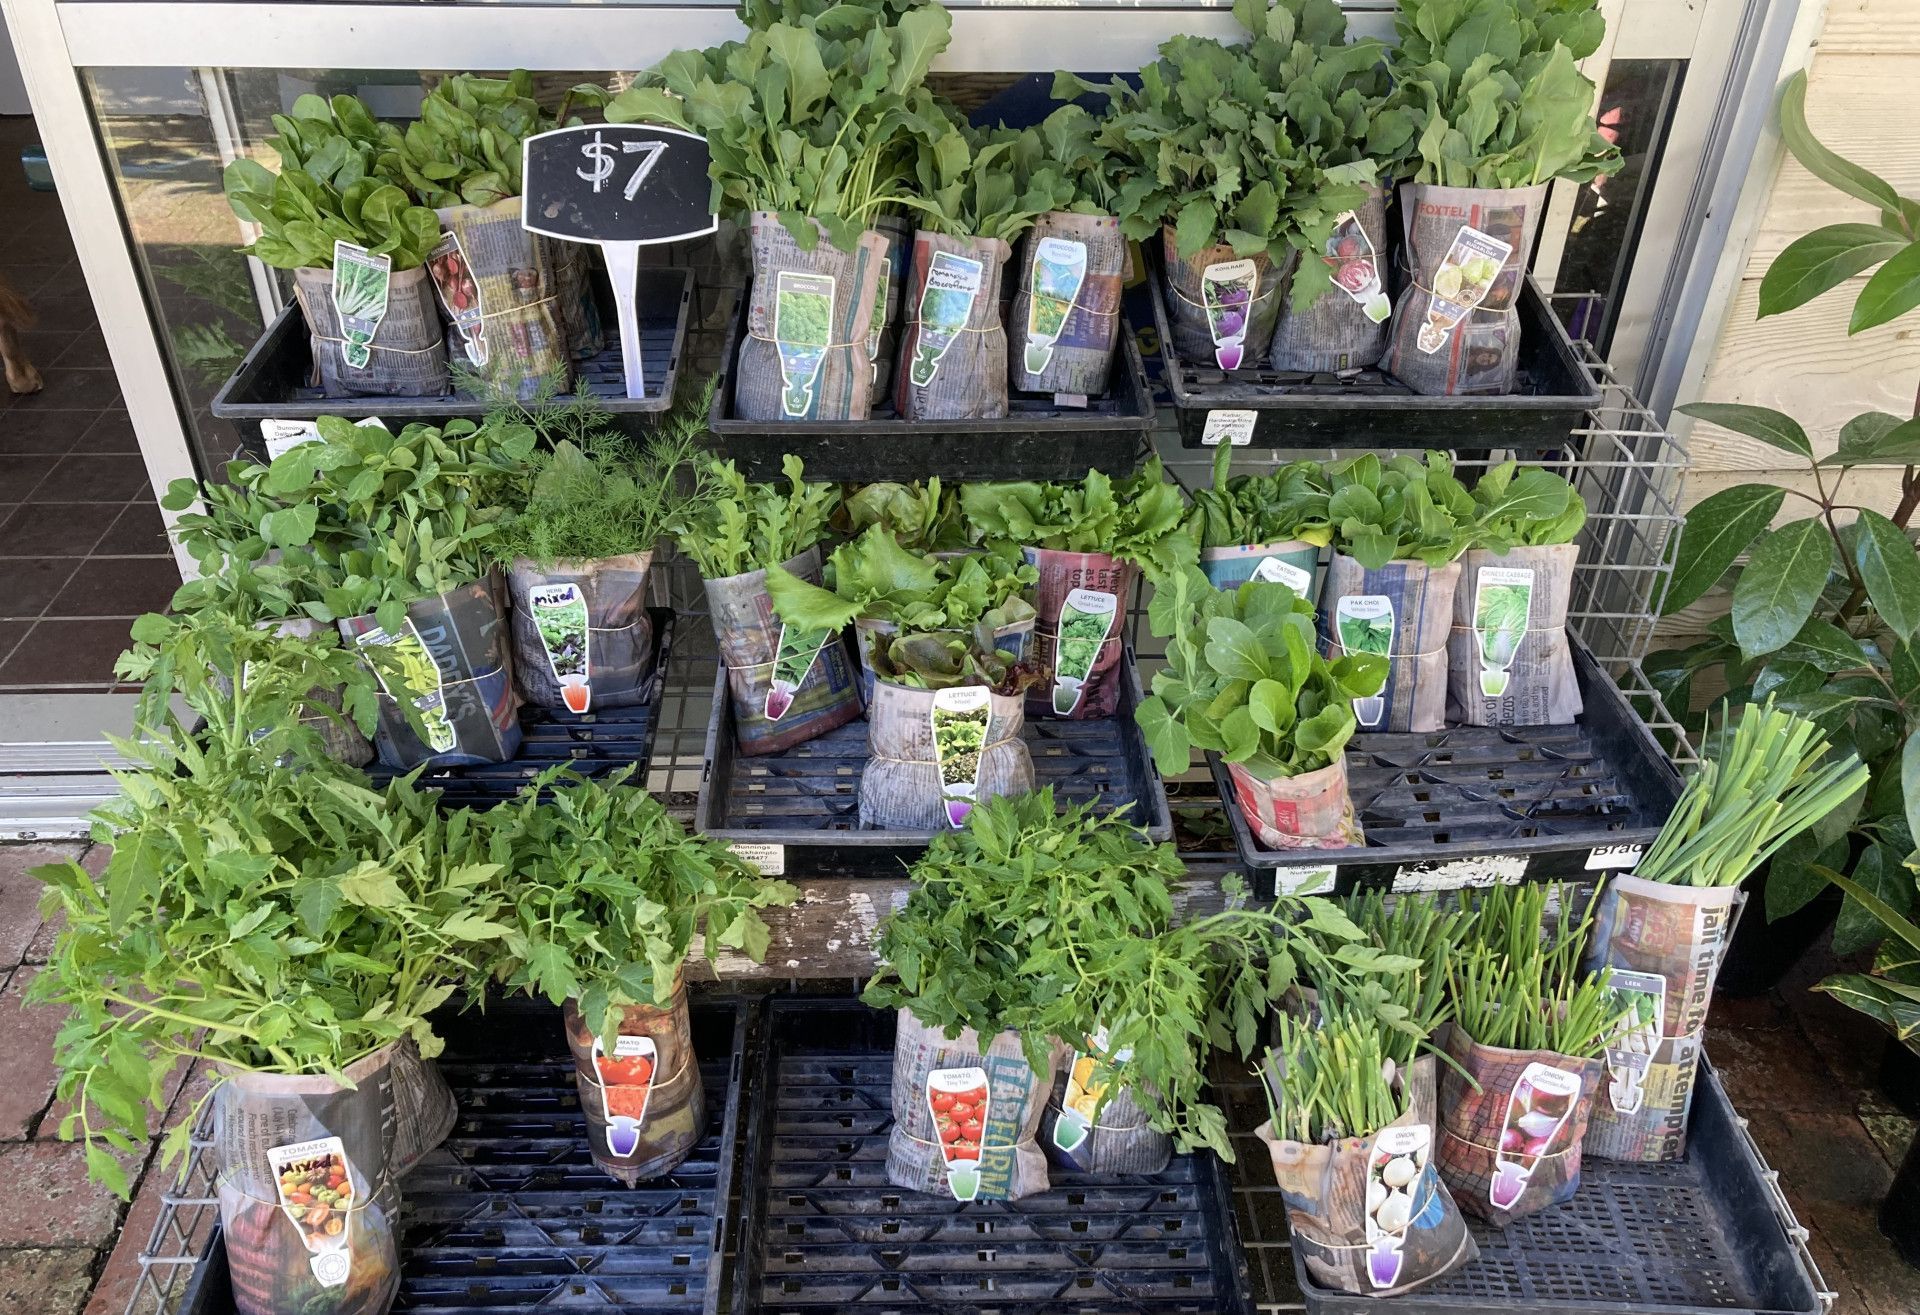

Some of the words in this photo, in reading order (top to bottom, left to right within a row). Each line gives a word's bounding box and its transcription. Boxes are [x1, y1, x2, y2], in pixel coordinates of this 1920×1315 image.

[576, 131, 670, 201] $7
[1419, 203, 1466, 218] FOXTEL
[1466, 240, 1497, 258] SUGARLOAF
[1214, 263, 1245, 272] KOHLRABI
[1072, 568, 1083, 588] top
[1099, 568, 1109, 590] last
[1506, 571, 1532, 579] CABBAGE
[1080, 594, 1105, 603] LETTUCE
[948, 691, 977, 699] LETTUCE
[1500, 695, 1515, 725] Bezos
[1700, 907, 1724, 945] jail
[1692, 949, 1715, 1003] time
[1543, 1070, 1565, 1081] ONION
[281, 1142, 328, 1155] TOMATO
[278, 1153, 332, 1176] Mixed
